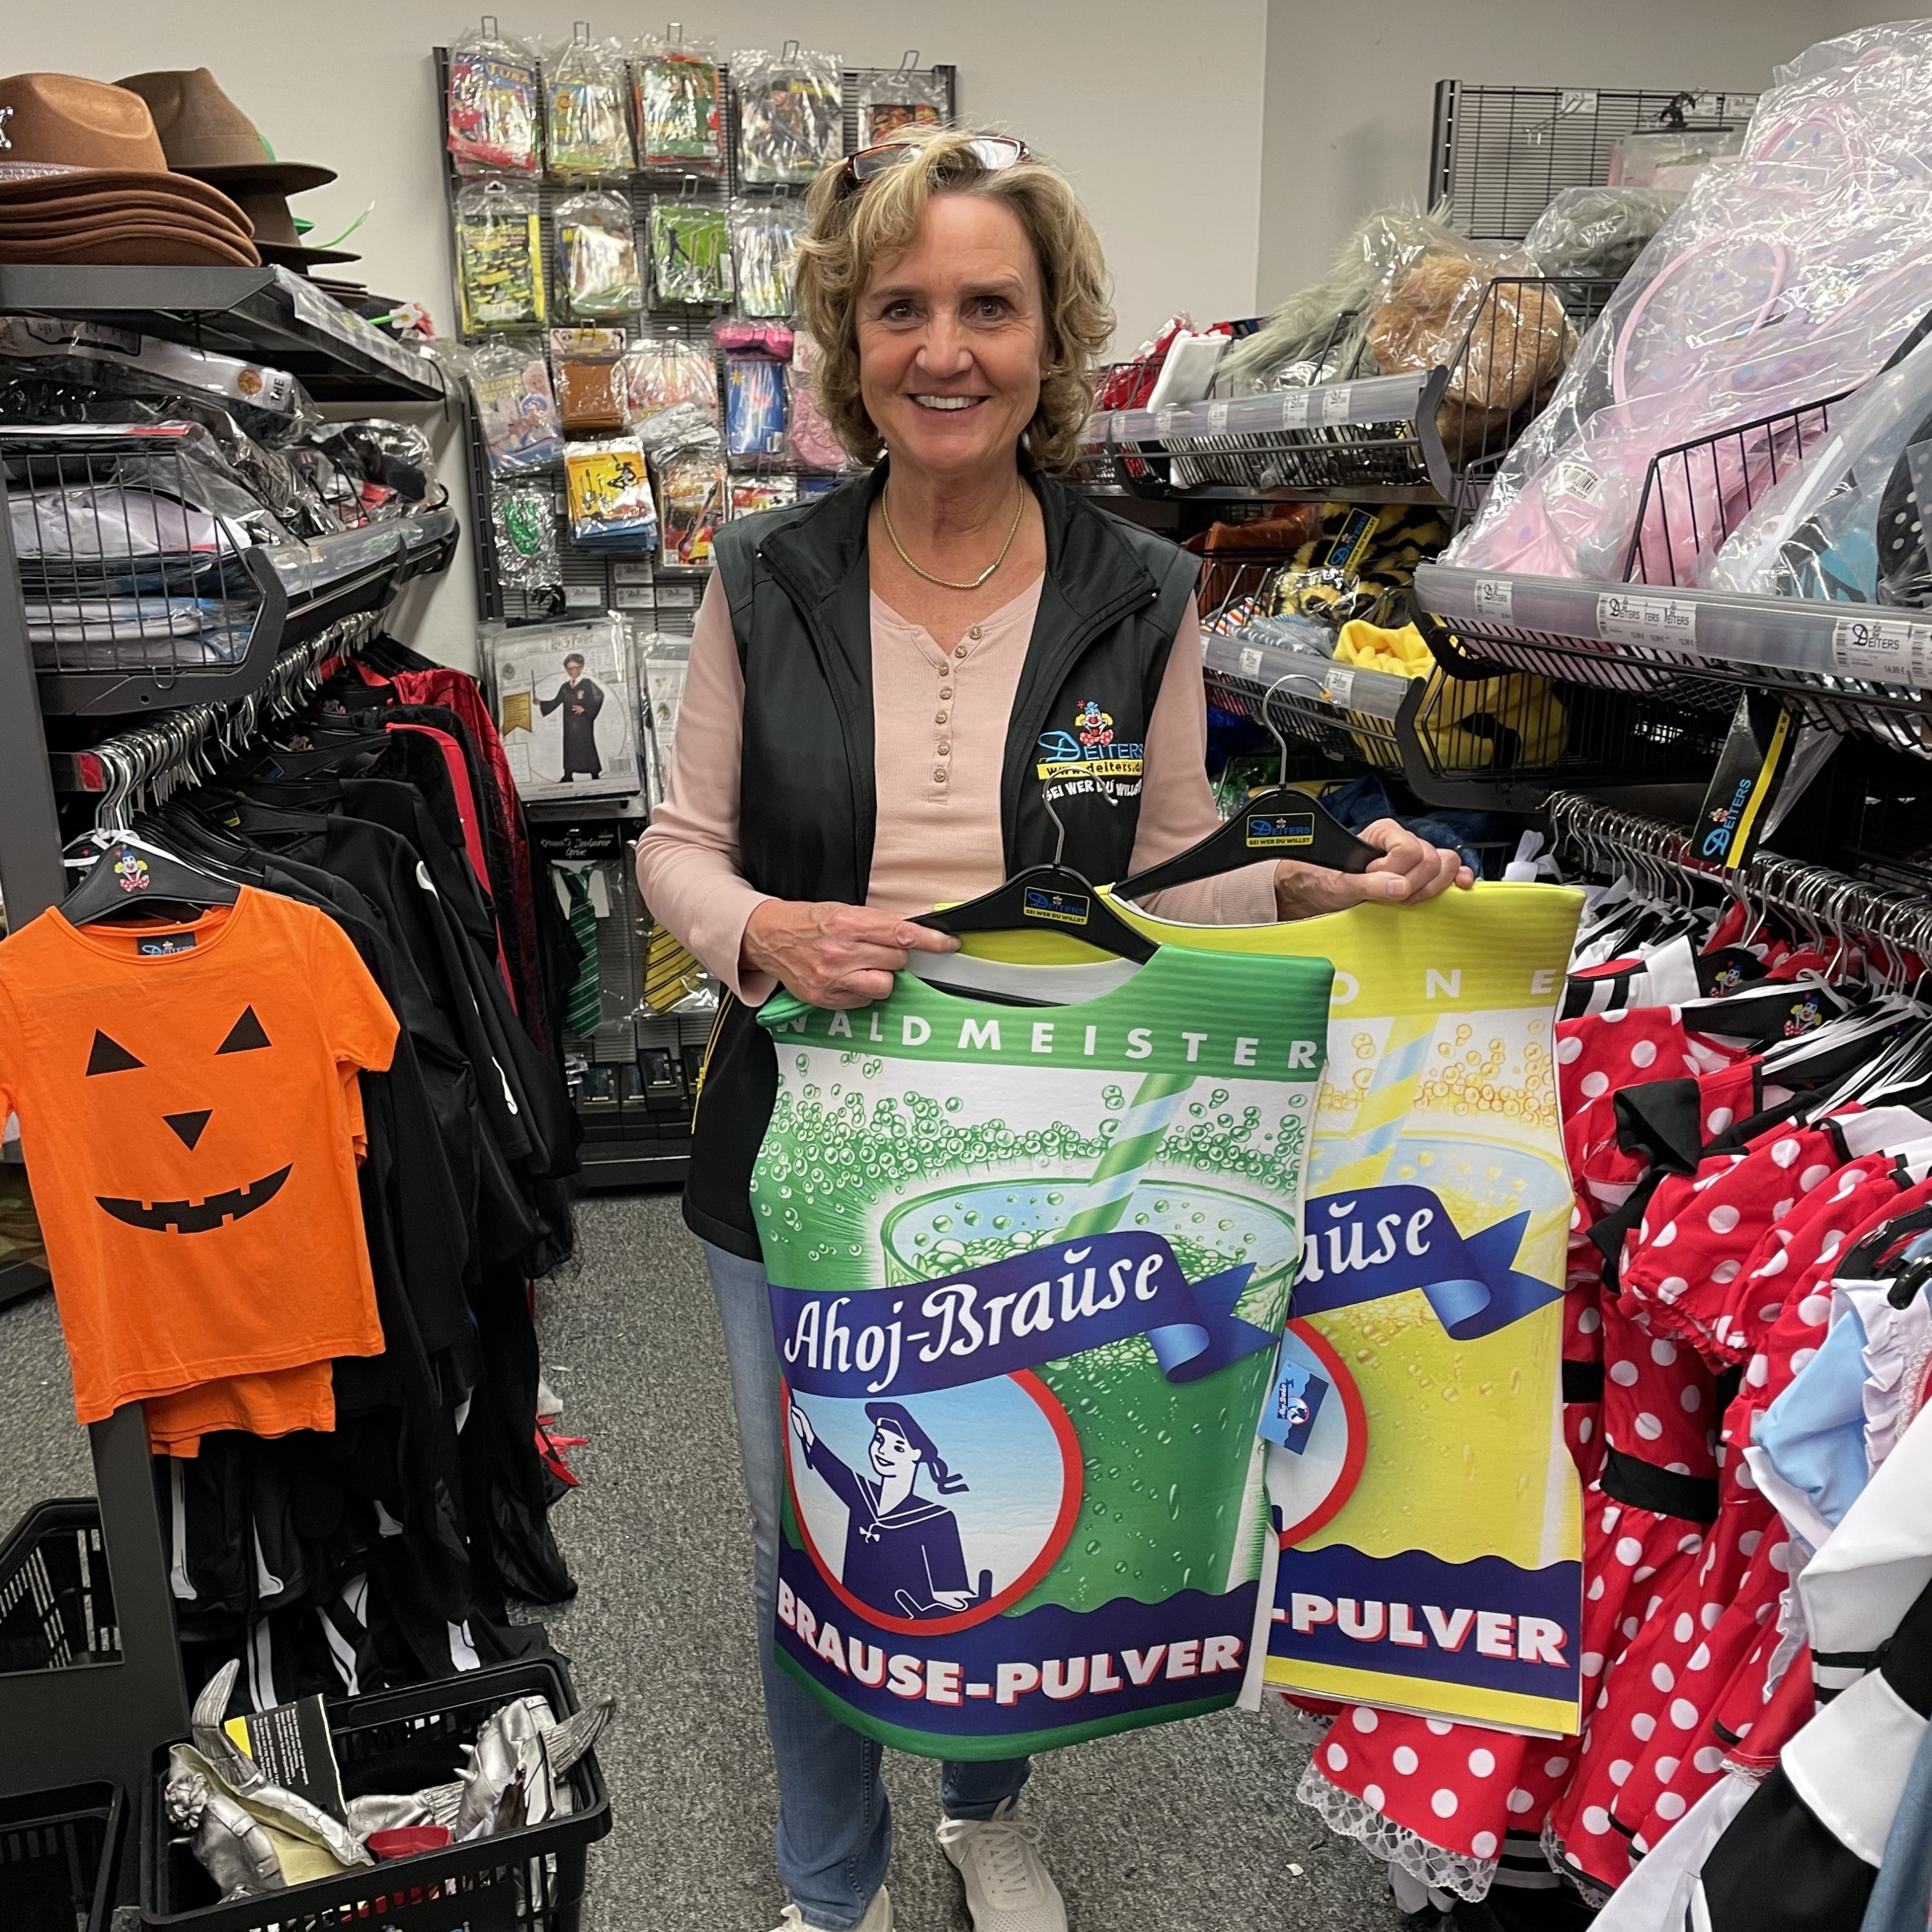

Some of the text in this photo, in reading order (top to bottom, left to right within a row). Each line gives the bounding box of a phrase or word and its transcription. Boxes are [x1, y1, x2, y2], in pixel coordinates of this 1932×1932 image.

[1609, 598, 1640, 620] DEITERS
[1645, 612, 1659, 622] TERS
[1852, 623, 1900, 650] DEITERS
[1037, 731, 1143, 762] DEITERS
[1065, 780, 1095, 796] WER
[1250, 820, 1311, 836] DEITERS
[1702, 777, 1752, 857] DEITERS
[1028, 892, 1085, 915] DEITERS
[778, 1577, 1244, 1707] BRAUSE-PULVER
[1272, 1593, 1571, 1668] -PULVER
